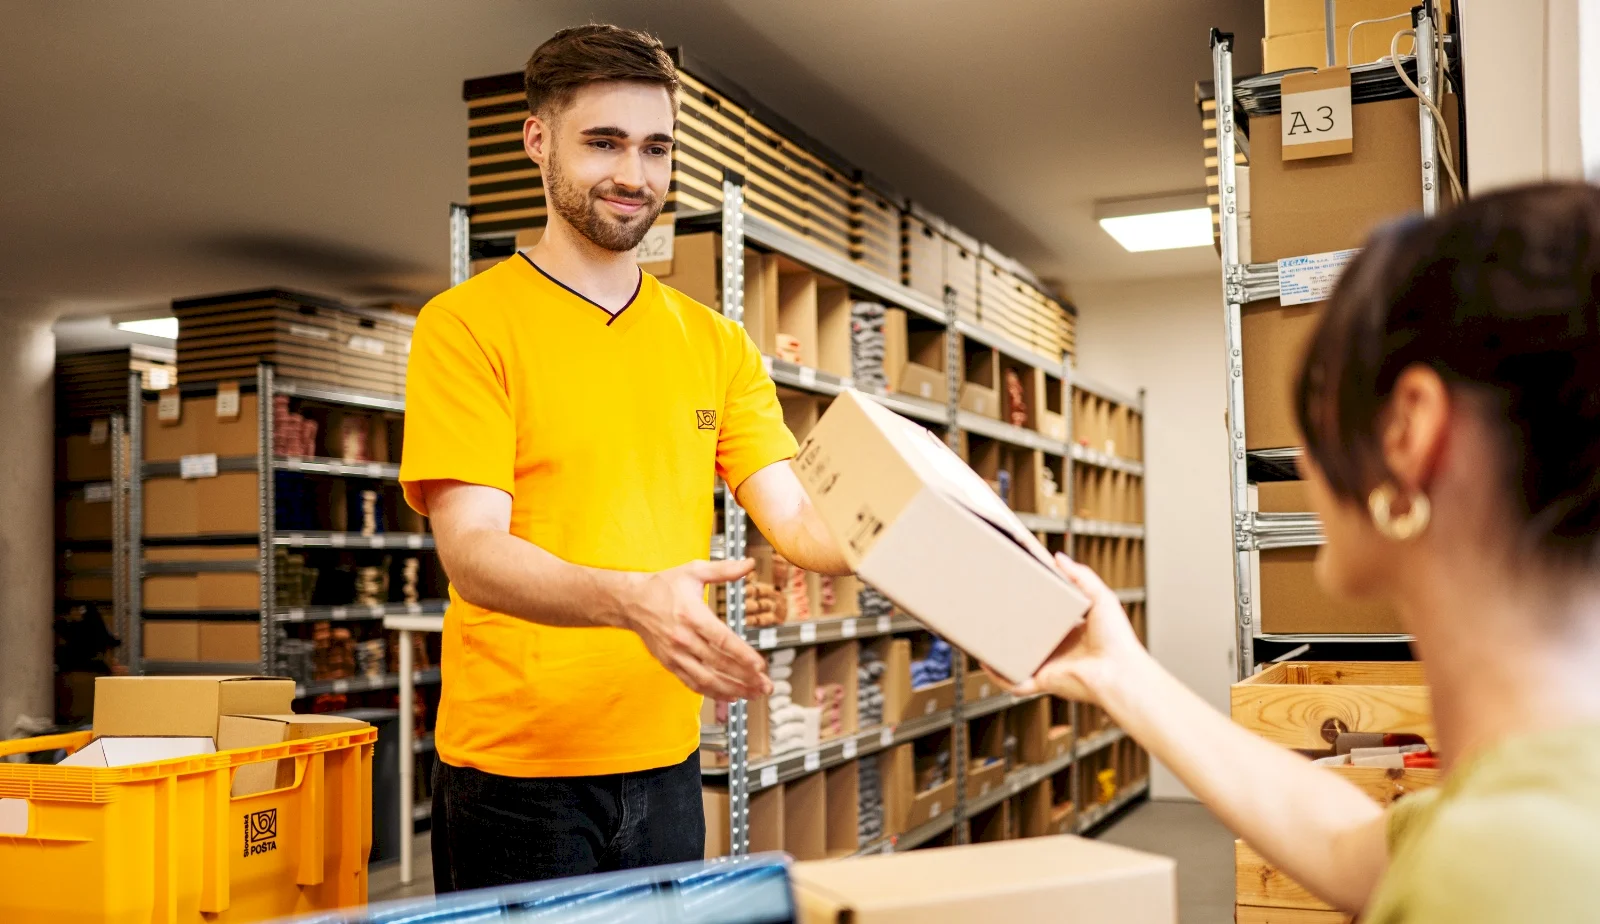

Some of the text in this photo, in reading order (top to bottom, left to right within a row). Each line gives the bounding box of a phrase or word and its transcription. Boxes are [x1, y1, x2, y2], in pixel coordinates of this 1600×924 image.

[1287, 105, 1335, 136] A3
[636, 235, 667, 258] A2
[250, 840, 277, 856] POŠTA
